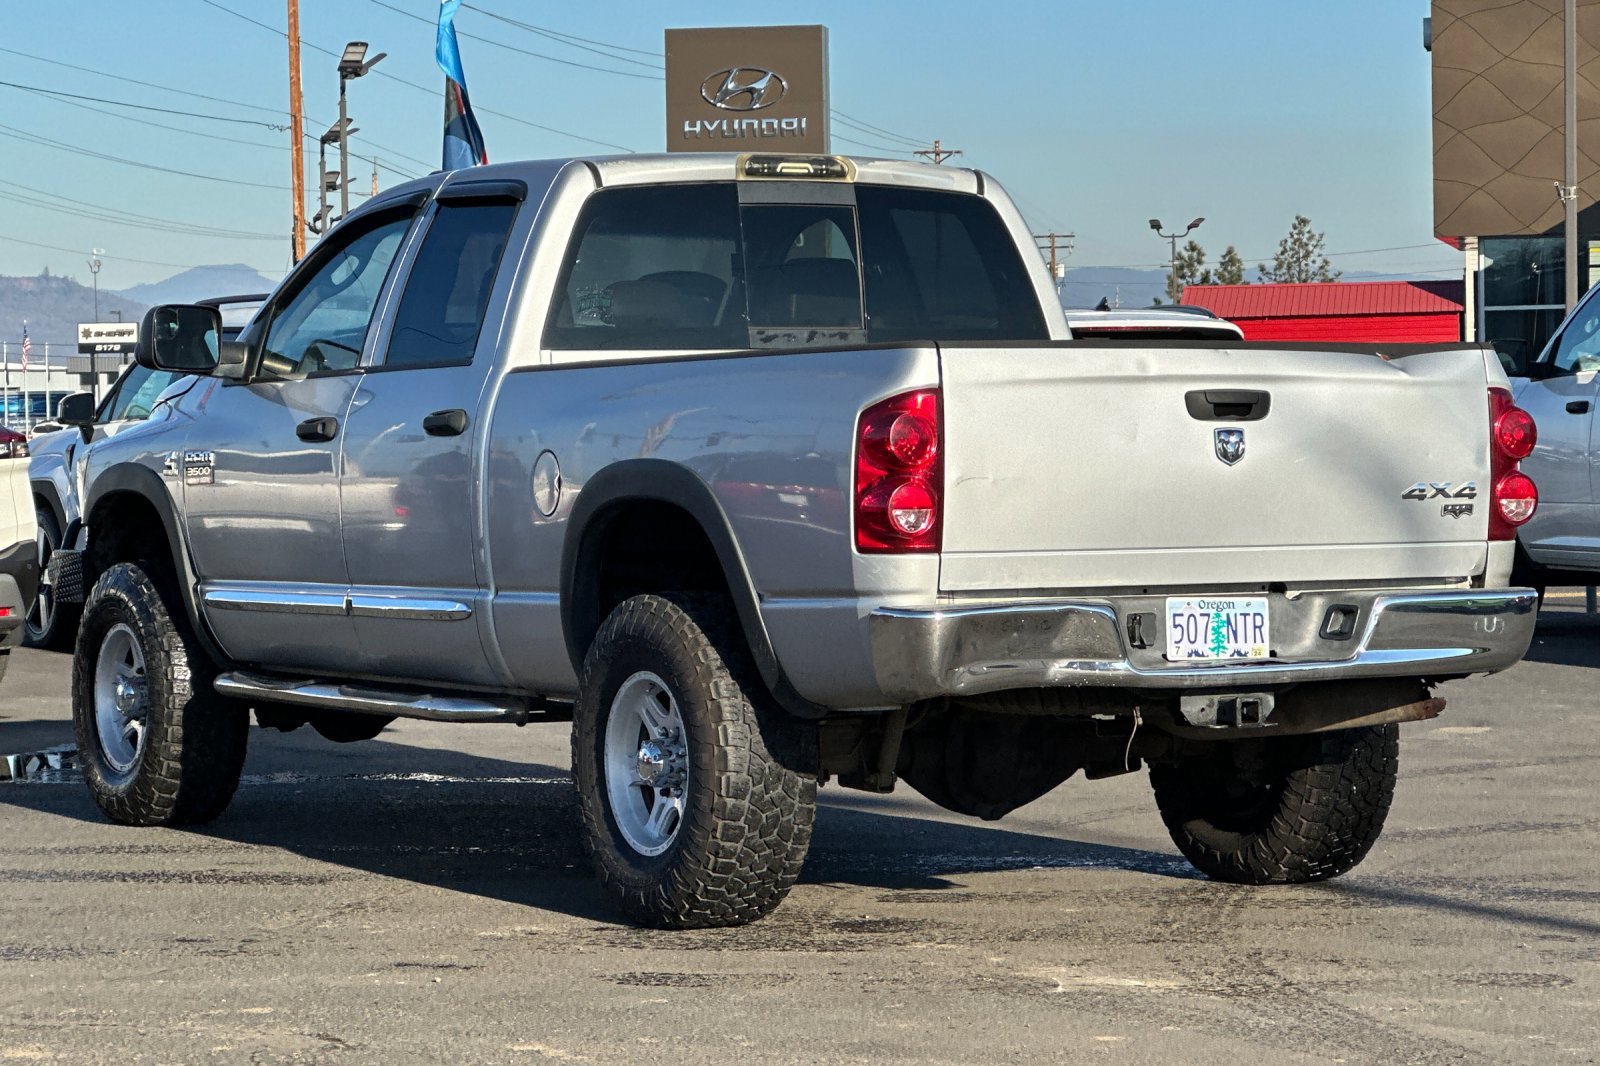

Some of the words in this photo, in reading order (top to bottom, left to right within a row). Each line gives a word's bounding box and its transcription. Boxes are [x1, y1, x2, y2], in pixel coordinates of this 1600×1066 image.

[684, 117, 807, 139] HYUNDAI
[187, 467, 211, 477] 3500
[1198, 599, 1236, 612] Oregon
[1172, 613, 1211, 645] 507
[1226, 612, 1265, 644] NTR
[1175, 646, 1180, 655] 7
